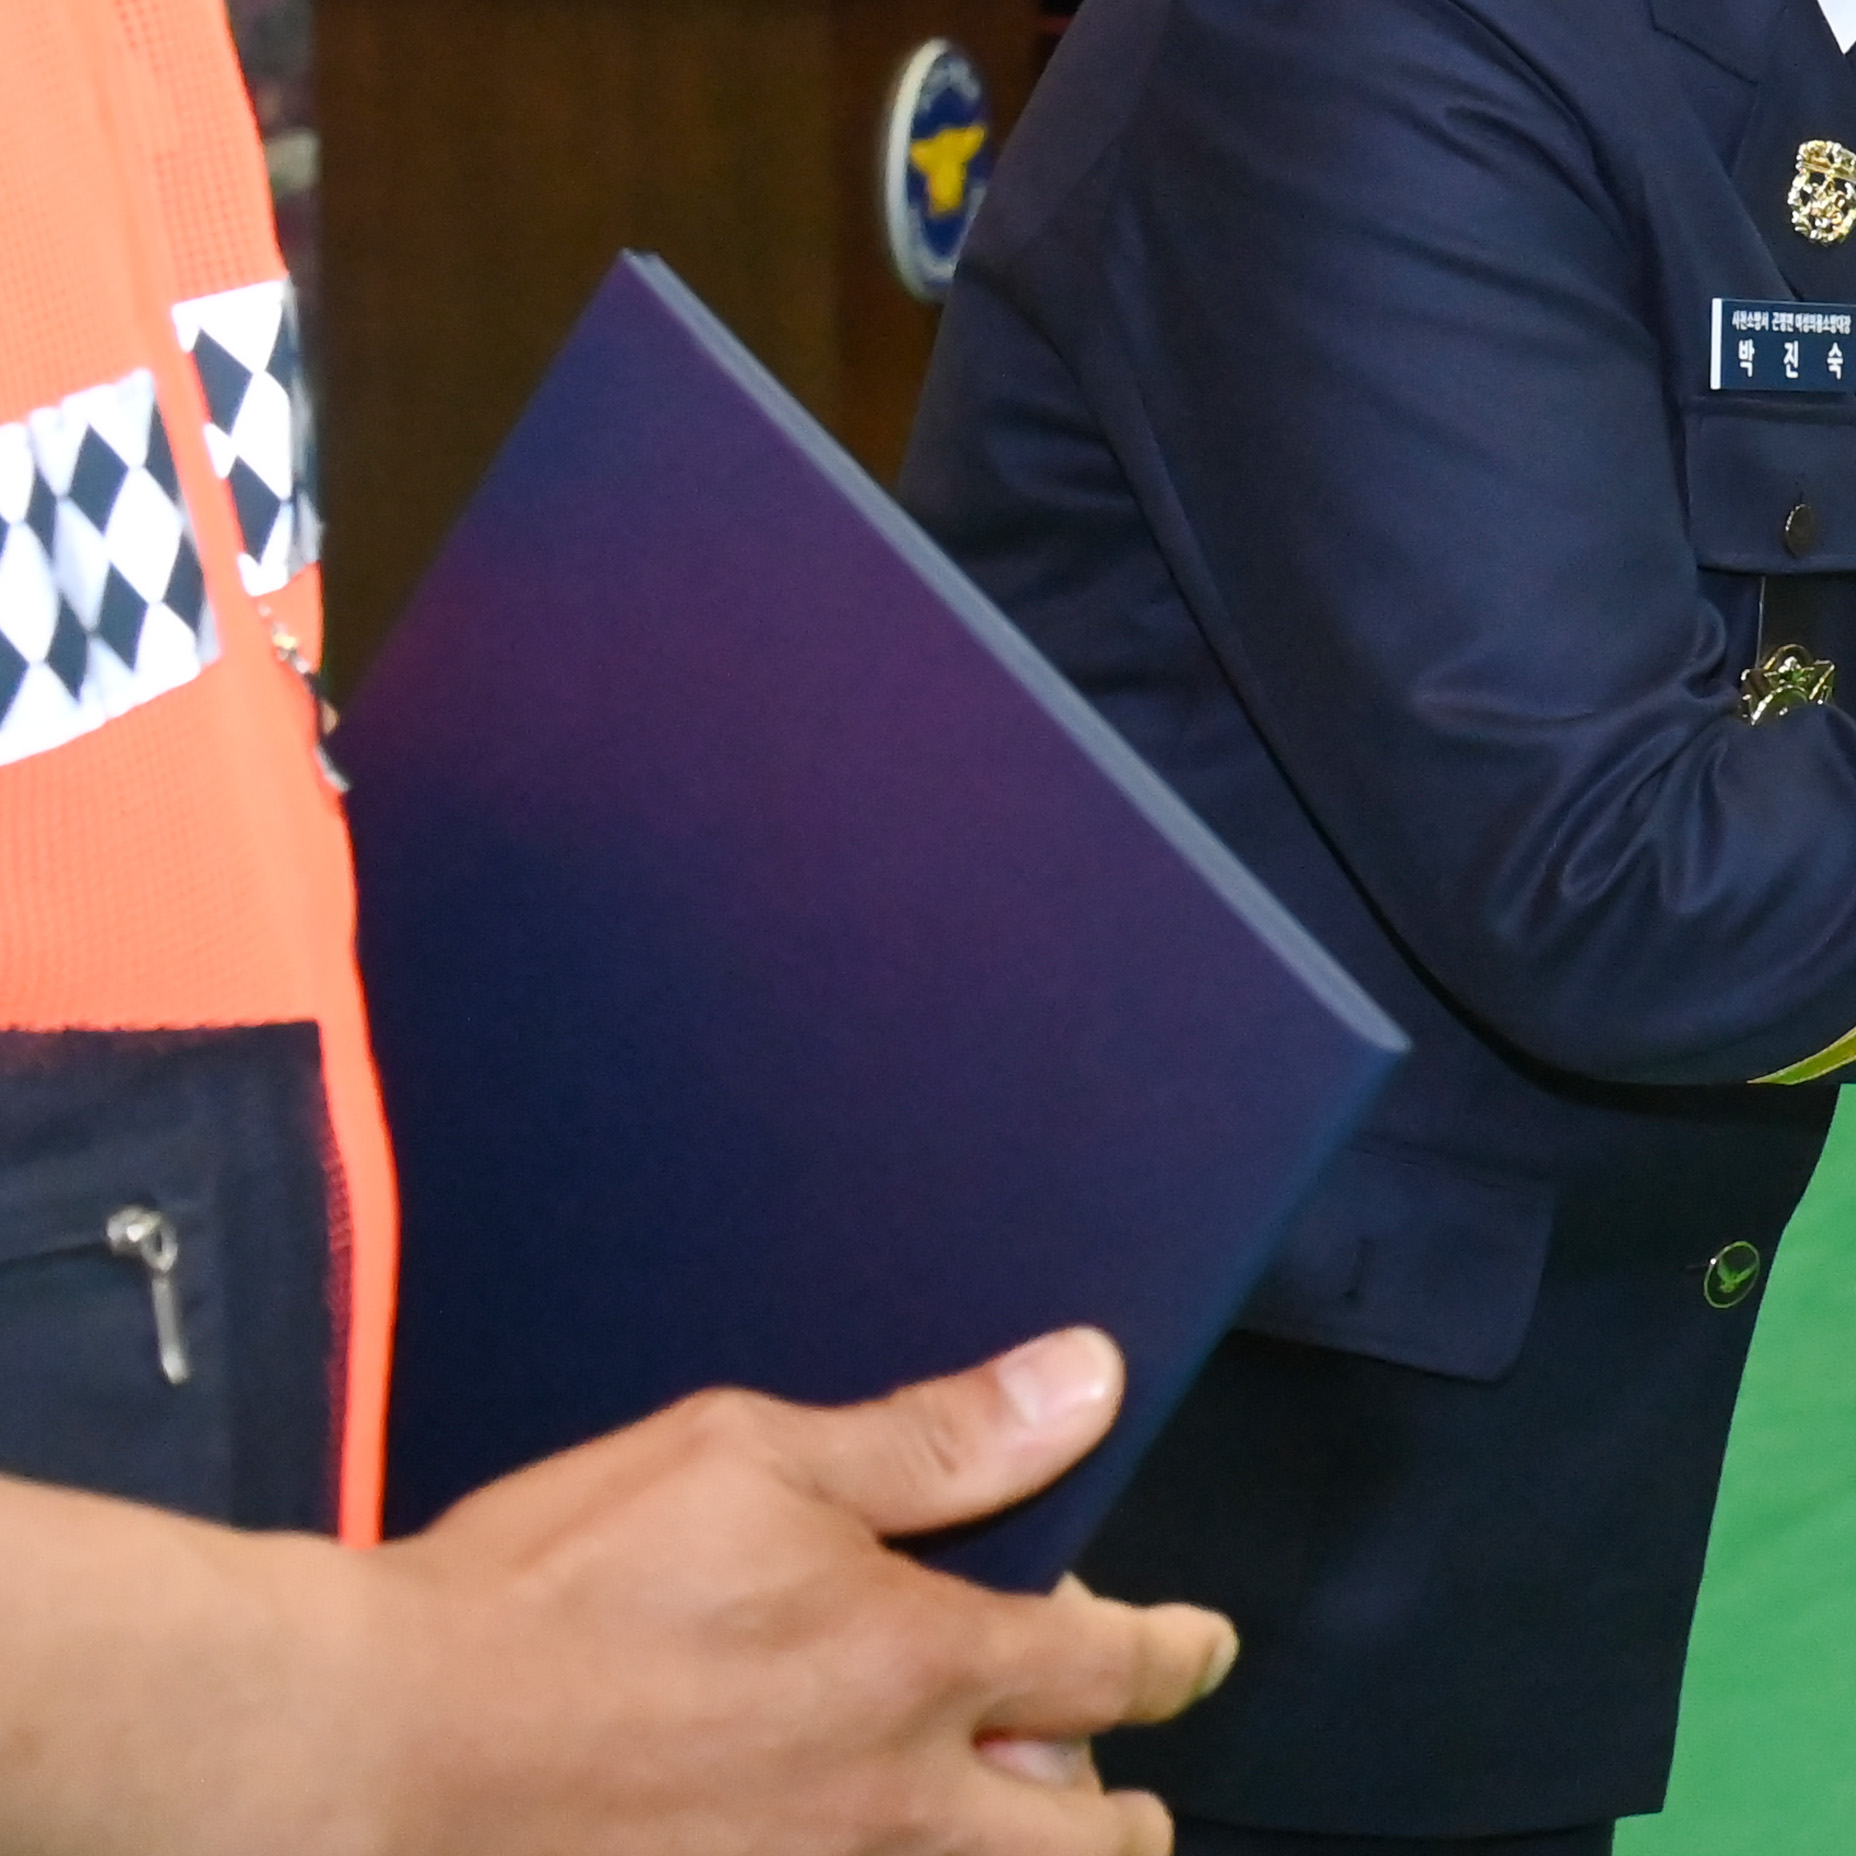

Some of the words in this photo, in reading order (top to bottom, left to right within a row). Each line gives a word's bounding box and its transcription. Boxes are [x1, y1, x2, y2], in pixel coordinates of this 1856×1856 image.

[1731, 309, 1769, 332] 사천소방서
[1771, 311, 1795, 333] 곤명면
[1795, 312, 1852, 335] 여성의용소방대장
